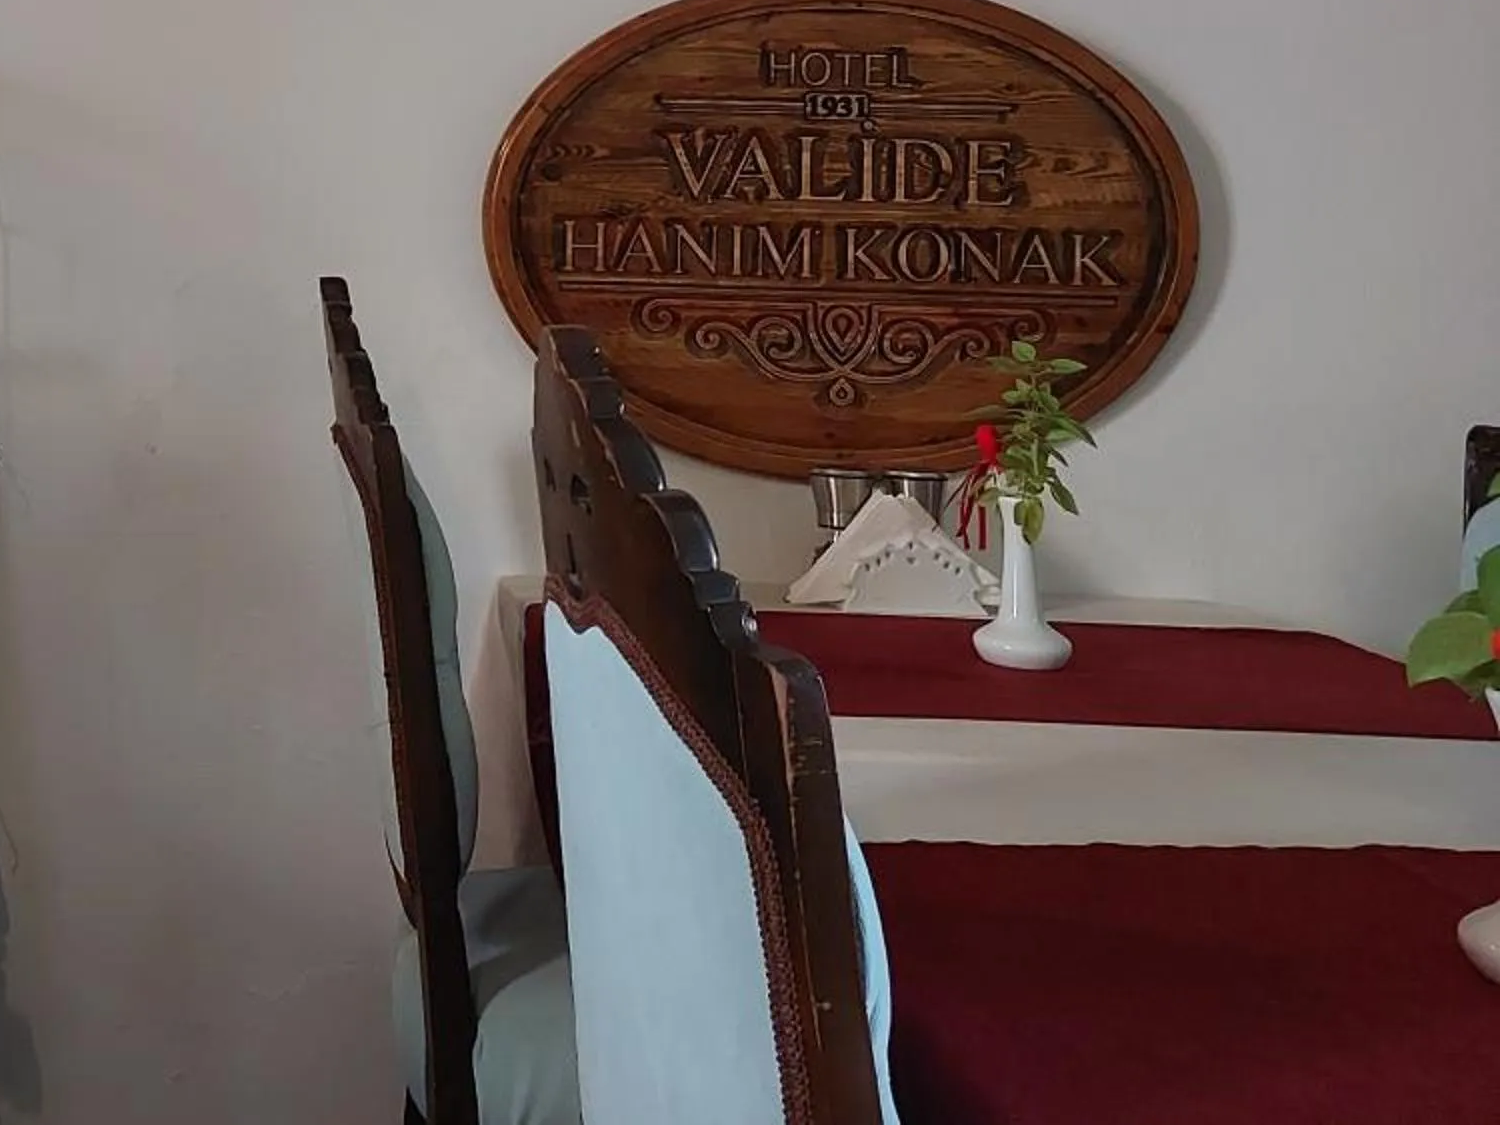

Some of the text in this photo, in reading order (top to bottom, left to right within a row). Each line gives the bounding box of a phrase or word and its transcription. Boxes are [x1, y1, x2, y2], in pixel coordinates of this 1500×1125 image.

[769, 51, 914, 87] HOTEL
[806, 95, 868, 118] 1931
[563, 220, 1119, 286] HANIM KONAK
